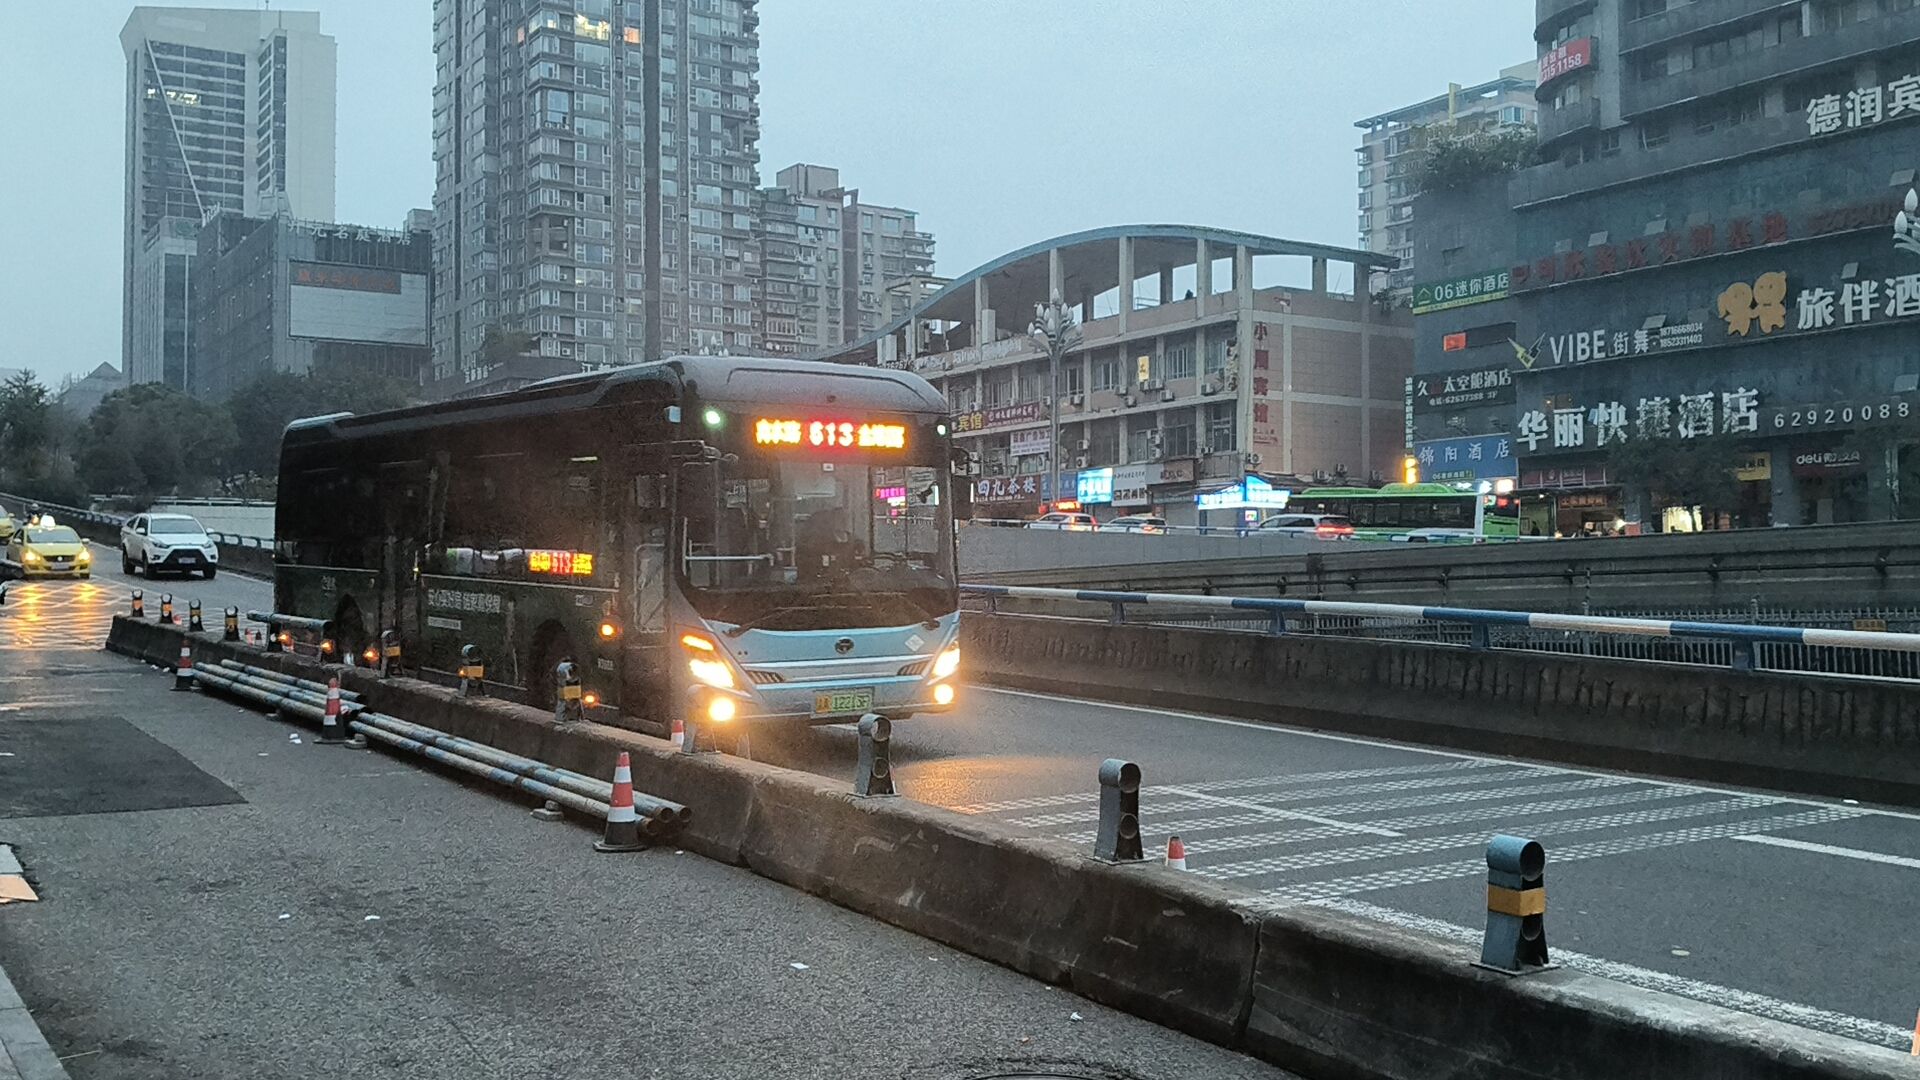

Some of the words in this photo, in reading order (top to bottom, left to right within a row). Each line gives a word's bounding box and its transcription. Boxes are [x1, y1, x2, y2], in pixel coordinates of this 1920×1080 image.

[1806, 74, 1920, 136] 德润宾
[1434, 272, 1509, 301] 06迷你酒店
[1796, 273, 1920, 330] 旅伴酒
[1549, 329, 1605, 364] VIBE
[1613, 328, 1649, 355] 街舞
[1516, 386, 1760, 452] 华丽快捷酒店
[1774, 401, 1911, 429] 62920088
[809, 421, 854, 447] 613
[1418, 438, 1511, 467] 锦阳酒店
[1796, 453, 1822, 465] deli
